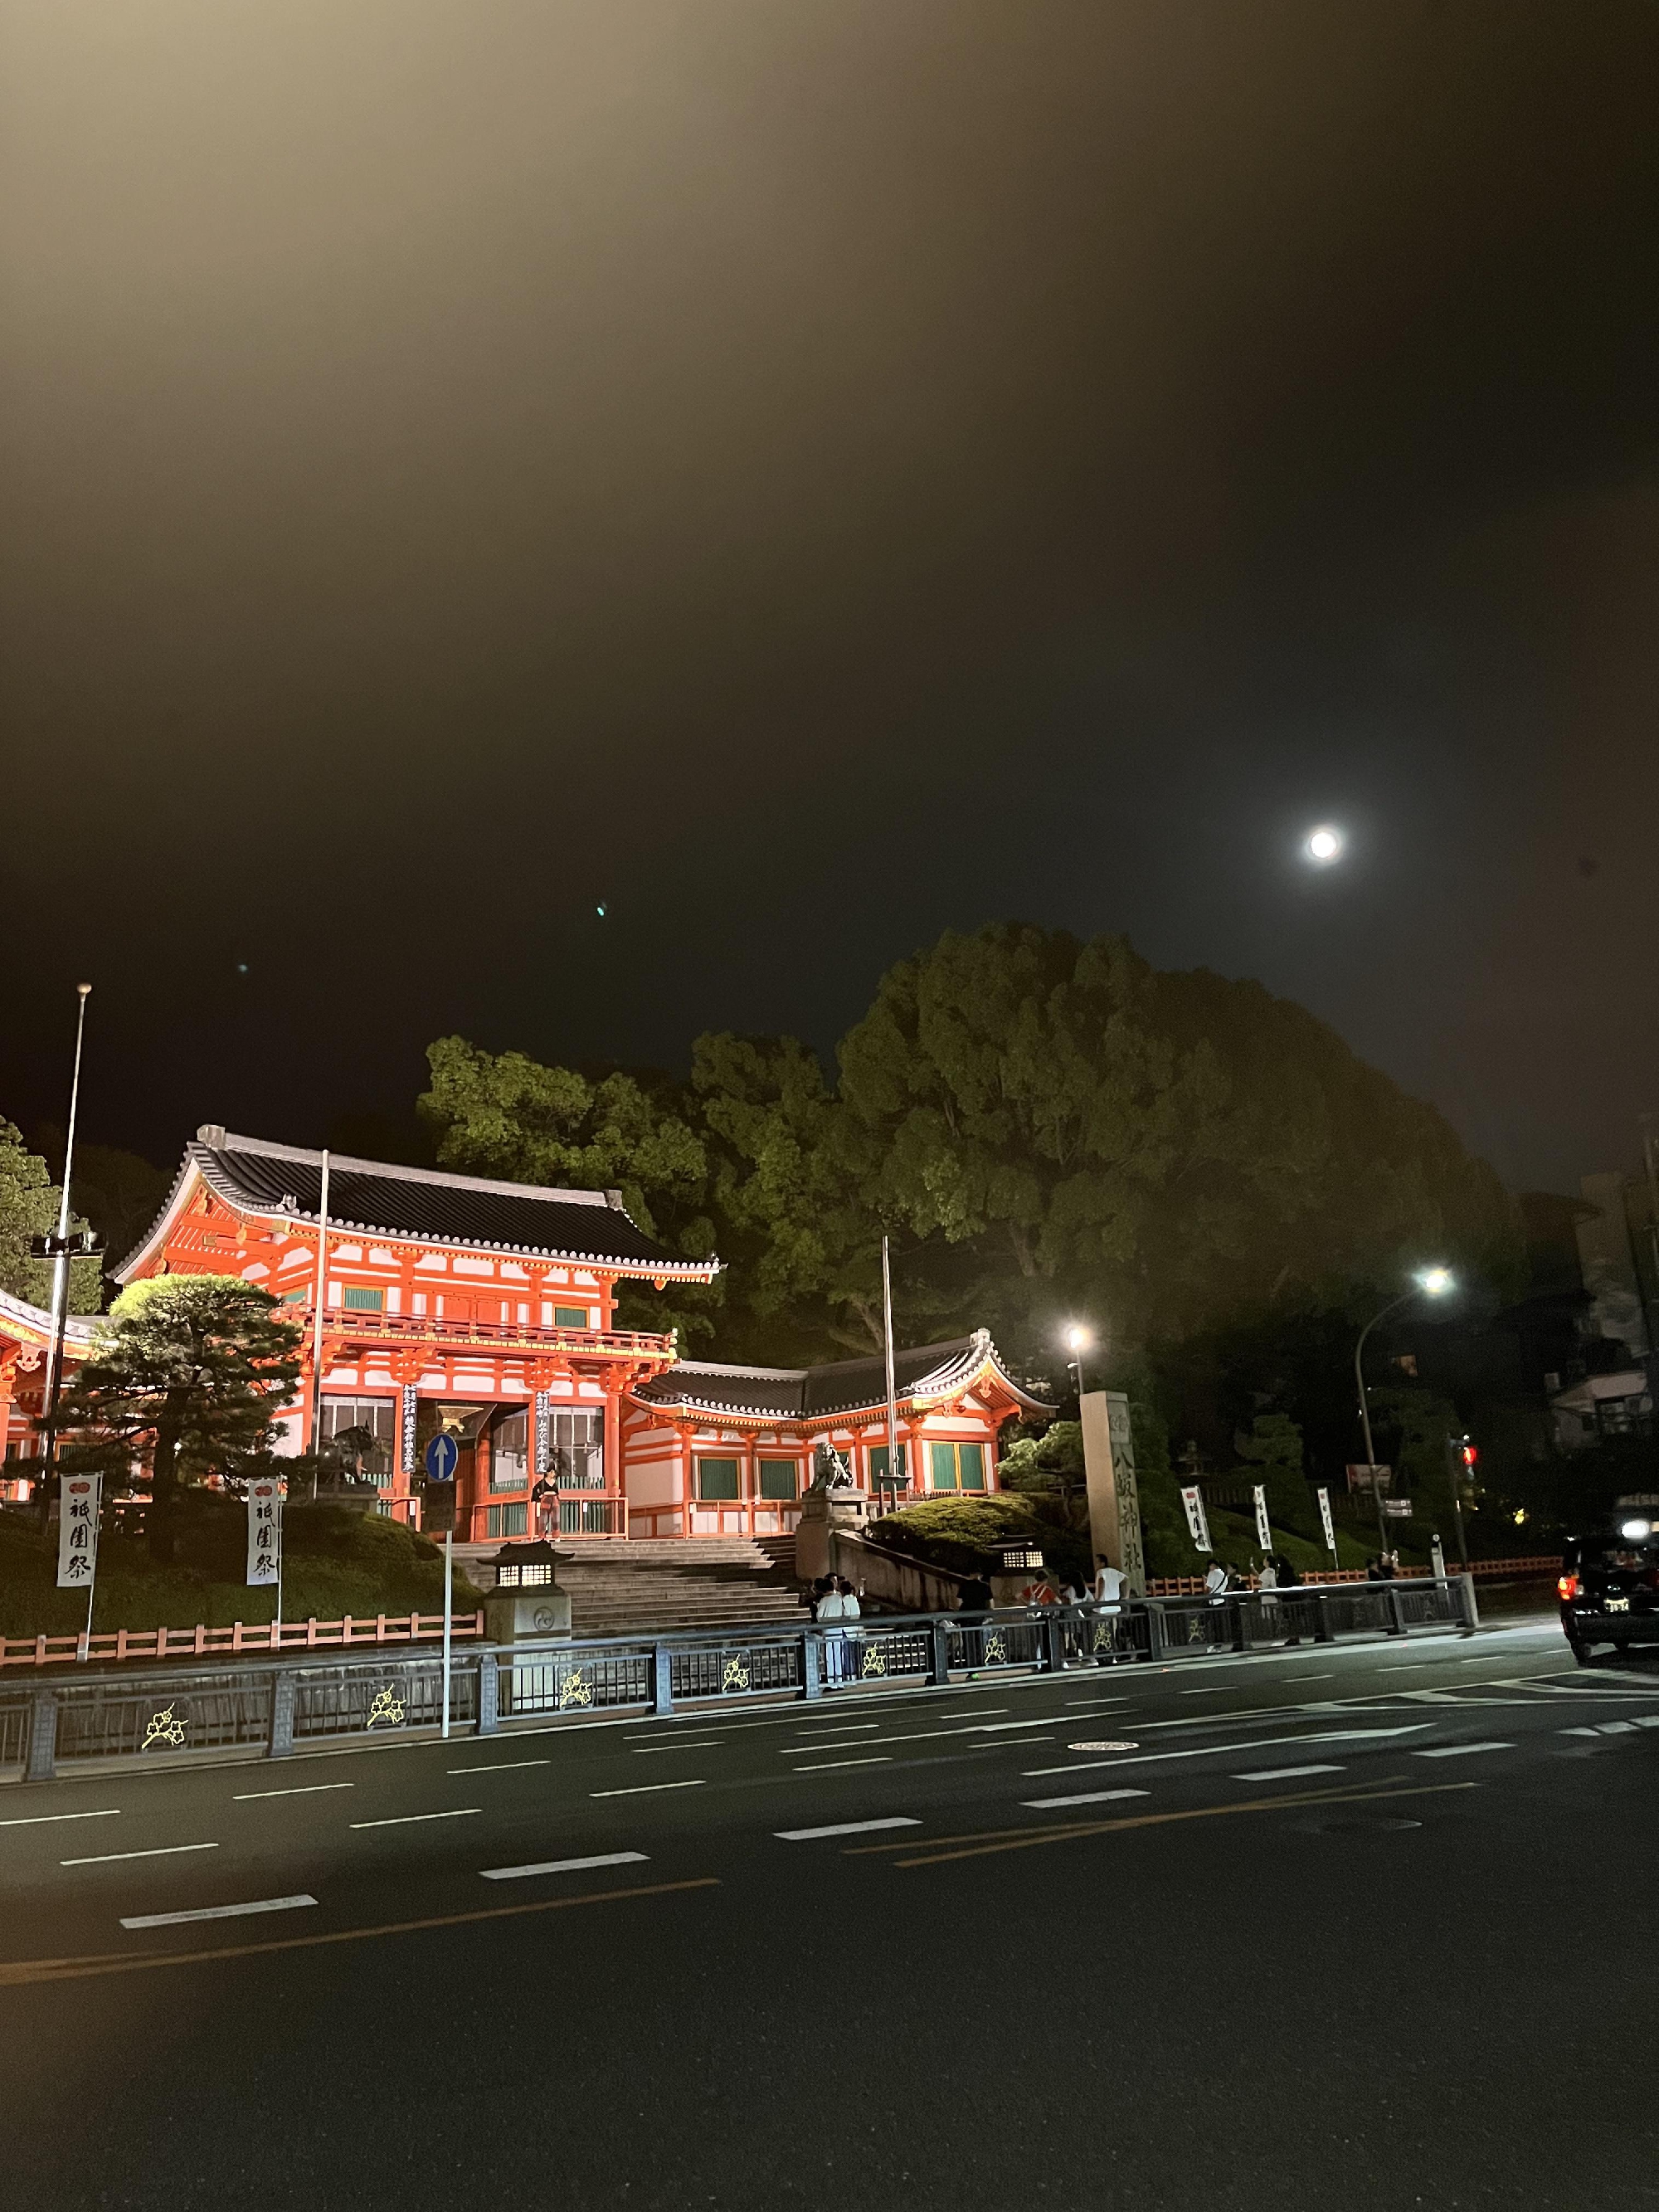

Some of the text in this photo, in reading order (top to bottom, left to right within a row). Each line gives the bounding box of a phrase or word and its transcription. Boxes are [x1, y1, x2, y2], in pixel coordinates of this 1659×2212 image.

[64, 1498, 93, 1580] 祇園祭
[253, 1500, 276, 1577] 祇園祭
[1114, 1450, 1142, 1573] 八坂神社
